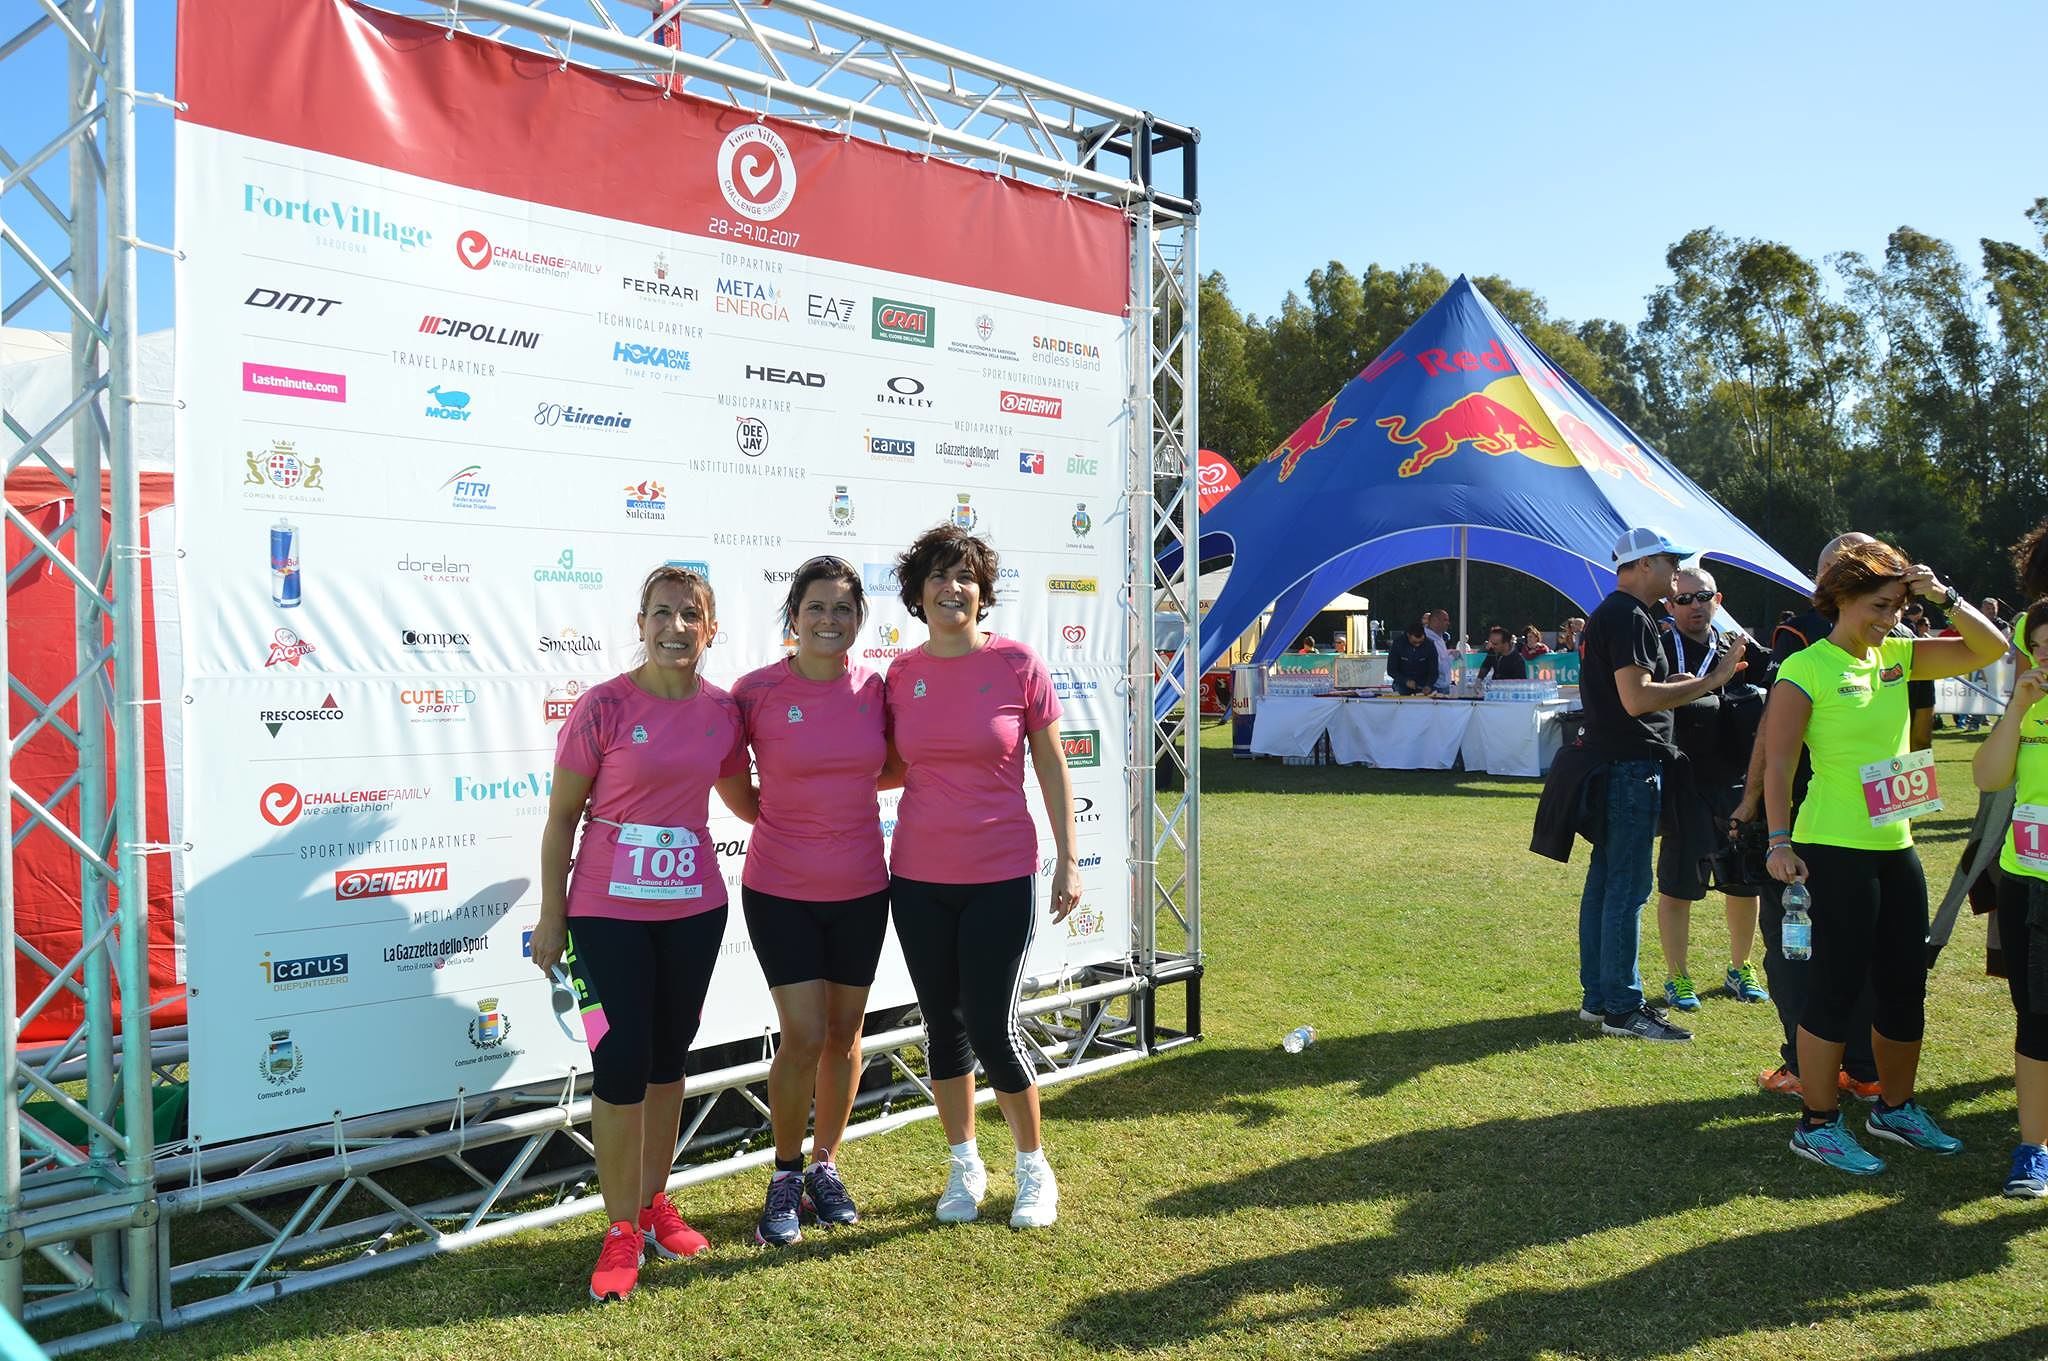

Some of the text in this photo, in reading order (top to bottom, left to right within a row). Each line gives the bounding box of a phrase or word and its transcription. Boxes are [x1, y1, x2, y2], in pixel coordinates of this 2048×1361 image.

[728, 128, 786, 160] Forte Village
[724, 179, 762, 215] CHALLENGE
[709, 217, 800, 248] 28-29.10.2017
[721, 253, 783, 273] TOP PARTNER
[623, 277, 699, 301] FERRARI
[716, 277, 766, 300] META
[244, 287, 342, 317] DMT
[716, 296, 790, 322] ENERGIA
[808, 294, 856, 322] EA7
[597, 311, 703, 338] TECHNICAL PARTNER
[881, 308, 925, 332] CRAI
[436, 317, 541, 350] CIPOLLINI
[613, 341, 668, 368] HOKA
[1033, 335, 1100, 359] SARDEGNA
[1416, 339, 1513, 377] Red
[392, 351, 496, 377] TRAVEL PARTNER
[1032, 351, 1101, 372] endless island
[252, 373, 338, 394] lastminute.com
[745, 365, 825, 388] HEAD
[983, 368, 1080, 391] SPORT NUTRITION PARTNER
[718, 394, 791, 412] MUSIC PARTNER
[877, 394, 933, 408] OAKLEY
[1018, 398, 1062, 416] ENERVIT
[425, 406, 471, 422] MOBY
[562, 405, 632, 429] tirrenia
[743, 424, 763, 438] DEE
[954, 421, 1013, 437] MEDIA PARTNER
[742, 437, 762, 451] JAY
[863, 428, 913, 455] icarus
[983, 446, 999, 461] Sport
[689, 459, 806, 480] INSTITUTIONAL PARTNER
[1066, 457, 1098, 476] BIKE
[455, 481, 491, 497] FITRI
[626, 508, 665, 520] Sulcitana
[714, 533, 782, 547] RACE PARTNER
[397, 552, 470, 574] dorelan
[534, 568, 603, 584] GRANAROLO
[578, 583, 604, 591] GROUP
[402, 629, 471, 648] Compex
[538, 634, 602, 656] Smeralda
[1528, 663, 1580, 682] Forte
[400, 689, 476, 704] CUTERED
[260, 708, 344, 722] FRESCOSECCO
[417, 704, 460, 713] SPORT
[453, 771, 552, 802] ForteVi
[1875, 769, 1929, 805] 109
[300, 833, 477, 860] SPORT NUTRITION PARTNER
[628, 847, 696, 878] 108
[369, 868, 446, 893] ENERVIT
[636, 878, 662, 886] Comune
[414, 902, 509, 925] MEDIA PARTNER
[383, 934, 489, 962] La Gazzetta dello Sport
[259, 952, 344, 984] icarus
[396, 964, 413, 972] Tutto
[420, 962, 433, 970] rosa
[454, 1057, 477, 1067] Comune
[257, 1089, 283, 1101] Comune
[284, 1087, 292, 1097] di
